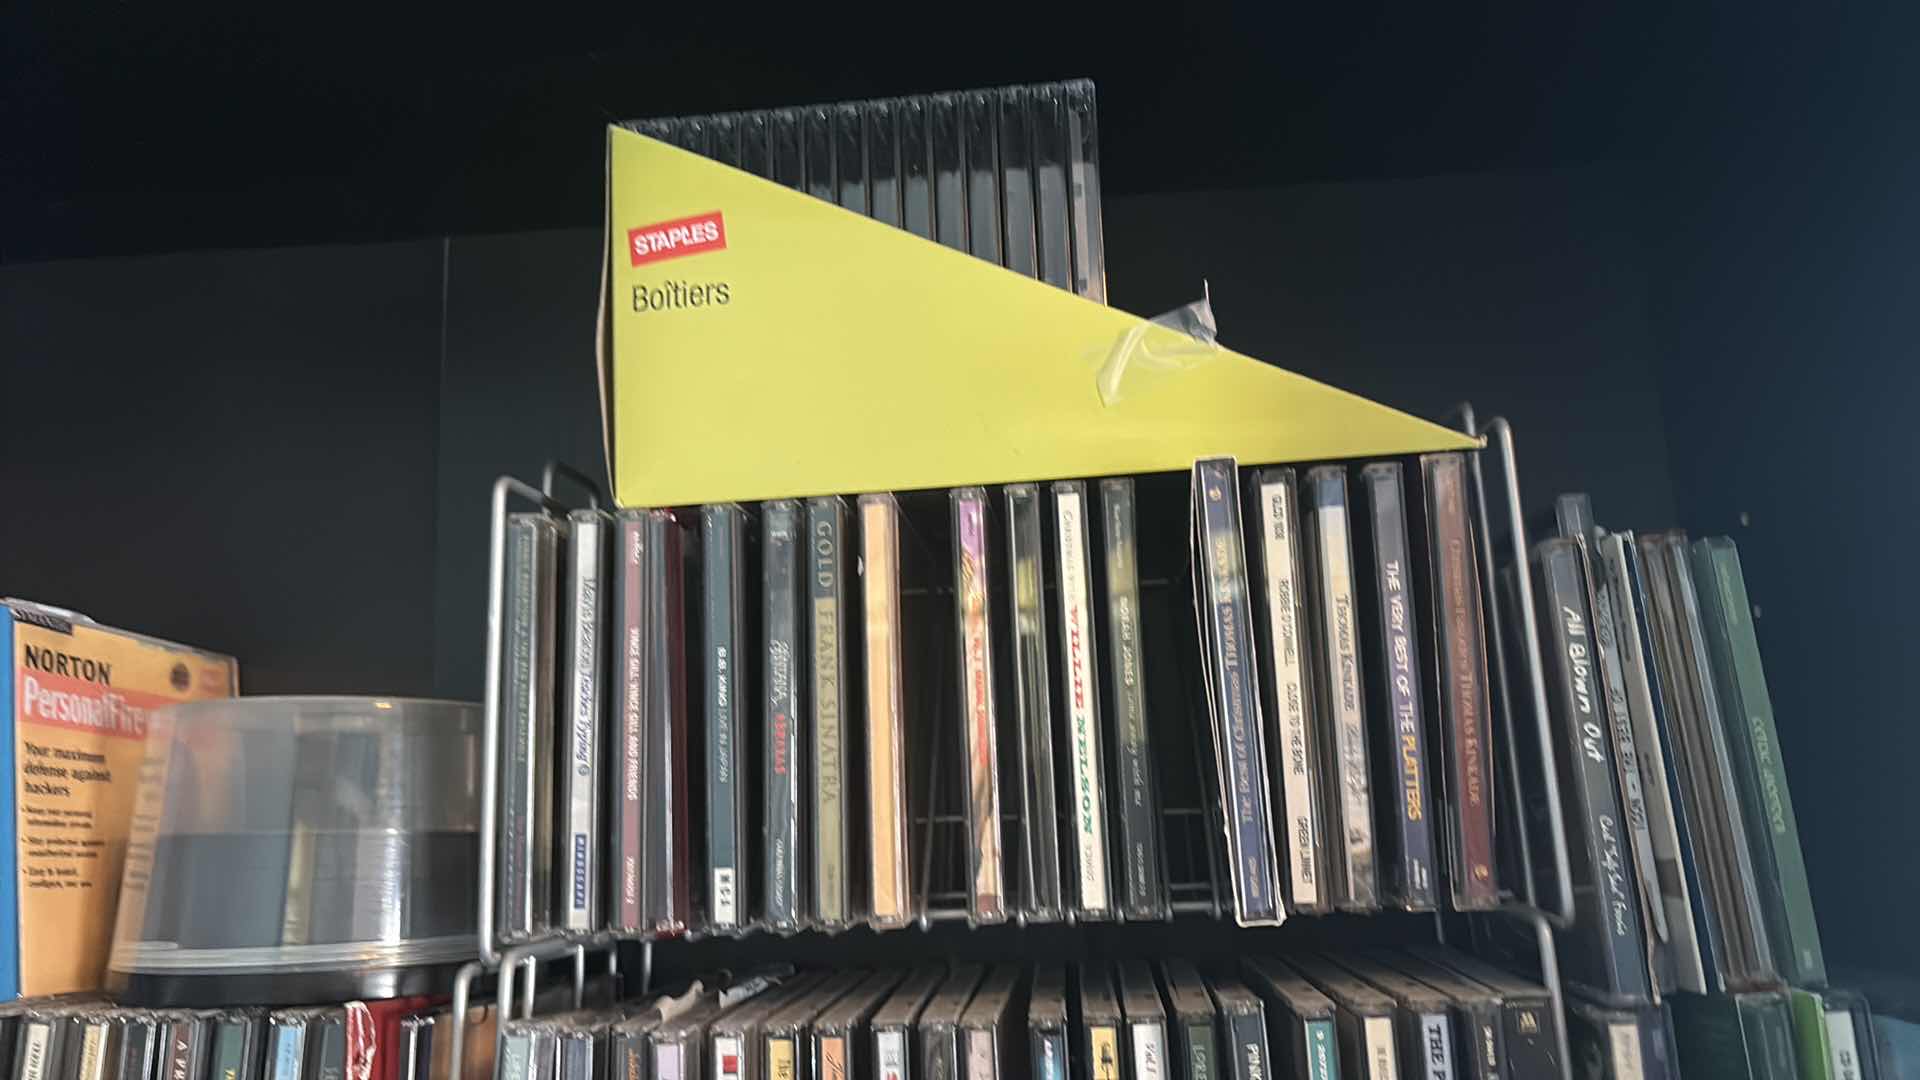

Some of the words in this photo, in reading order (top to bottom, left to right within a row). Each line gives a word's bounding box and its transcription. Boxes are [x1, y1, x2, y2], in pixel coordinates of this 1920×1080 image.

[634, 220, 721, 256] STAPLES
[632, 280, 730, 313] Boîtiers
[816, 520, 834, 588] GOLD
[1386, 561, 1400, 592] THE
[1389, 594, 1403, 632] VERY
[1563, 606, 1586, 635] All
[26, 644, 112, 688] NORTON
[818, 608, 836, 689] FRANK
[1069, 604, 1084, 709] WILLIE
[1393, 635, 1408, 673] BEST
[1395, 674, 1411, 697] OF
[1568, 642, 1593, 714] Blown
[25, 676, 150, 736] PersonalFire
[1398, 701, 1415, 733] THE
[820, 697, 838, 804] SINATRA
[1583, 721, 1605, 763] Out
[1076, 714, 1093, 834] NELSON
[1400, 734, 1422, 823] PLATTERS
[1296, 815, 1309, 848] GREEN
[1427, 1024, 1445, 1065] THE
